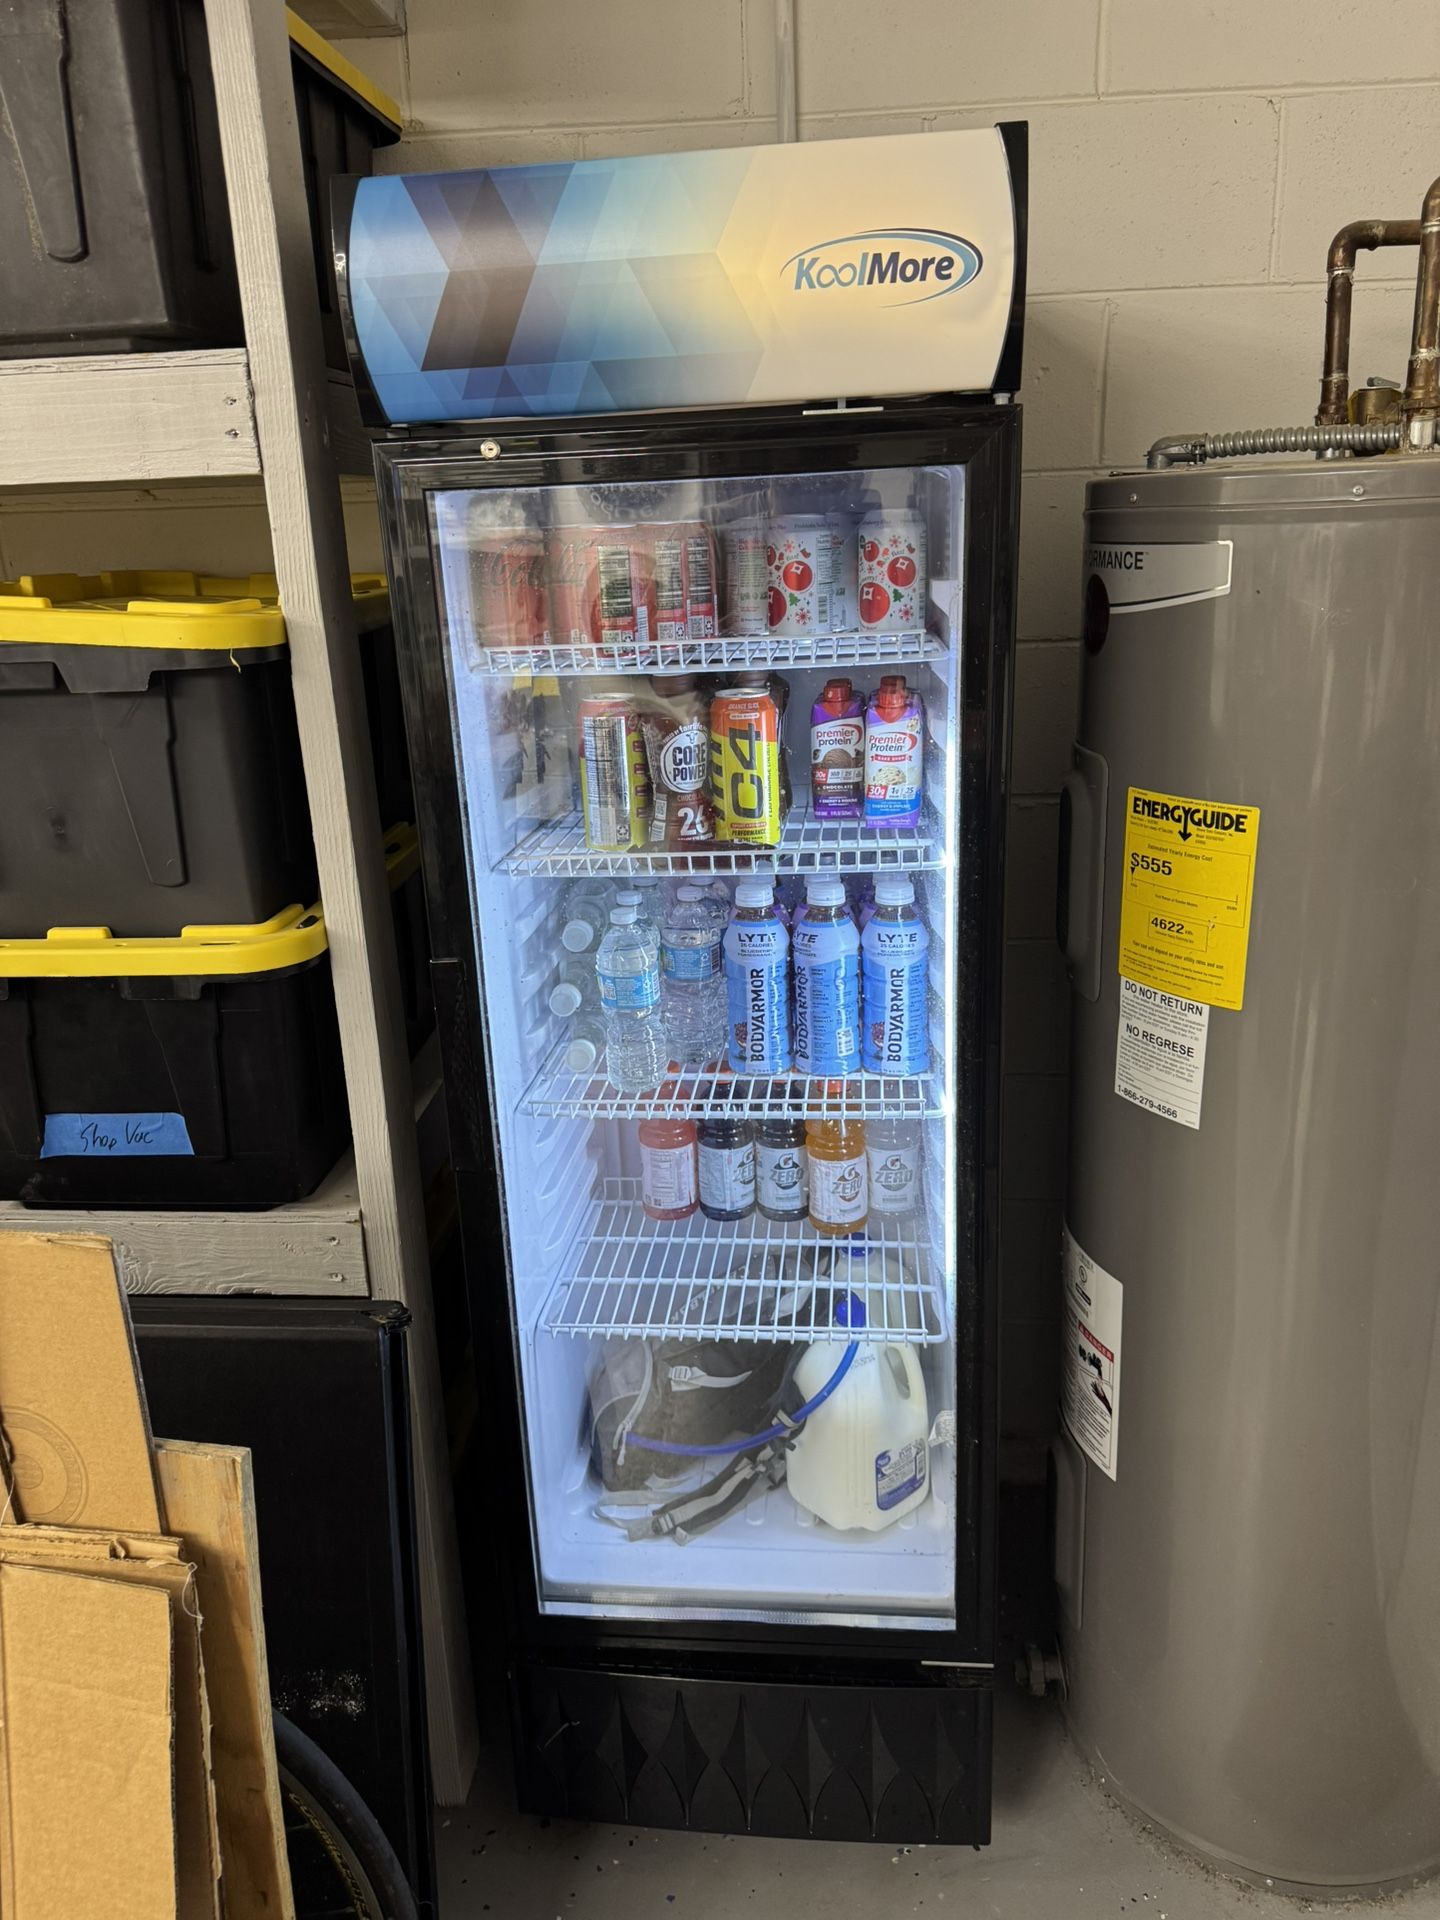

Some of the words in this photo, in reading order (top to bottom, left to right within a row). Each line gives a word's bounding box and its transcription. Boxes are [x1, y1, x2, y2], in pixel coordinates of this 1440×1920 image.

[794, 251, 954, 290] KoolMore
[816, 728, 855, 740] premier
[818, 737, 852, 747] protein
[869, 734, 907, 744] Premier
[672, 742, 706, 767] CORE
[870, 743, 903, 752] Protein
[673, 763, 706, 782] POWER
[728, 723, 763, 819] C4
[869, 785, 886, 796] 30g
[677, 805, 710, 837] 26
[1133, 796, 1248, 834] ENERGYGUIDE
[731, 828, 767, 836] PERFORMANCE
[1131, 852, 1172, 876] $555
[1151, 917, 1185, 935] 4622
[738, 932, 776, 943] LYTE
[877, 932, 917, 943] LYTE
[1125, 980, 1137, 994] DO
[1139, 985, 1158, 1002] NOT
[1160, 994, 1203, 1016] RETURN
[750, 968, 765, 1062] BODYARMOR
[796, 966, 809, 1060] BODYARMOR
[887, 968, 904, 1062] BODYARMOR
[1126, 1022, 1139, 1037] NO
[1142, 1030, 1194, 1058] REGRESE
[1118, 1084, 1178, 1119] 1-866-279-4566
[80, 1122, 117, 1152] Shop
[125, 1121, 154, 1144] Vac
[769, 1169, 804, 1182] ZERO
[830, 1175, 863, 1195] ZERO
[874, 1169, 914, 1184] ZERO
